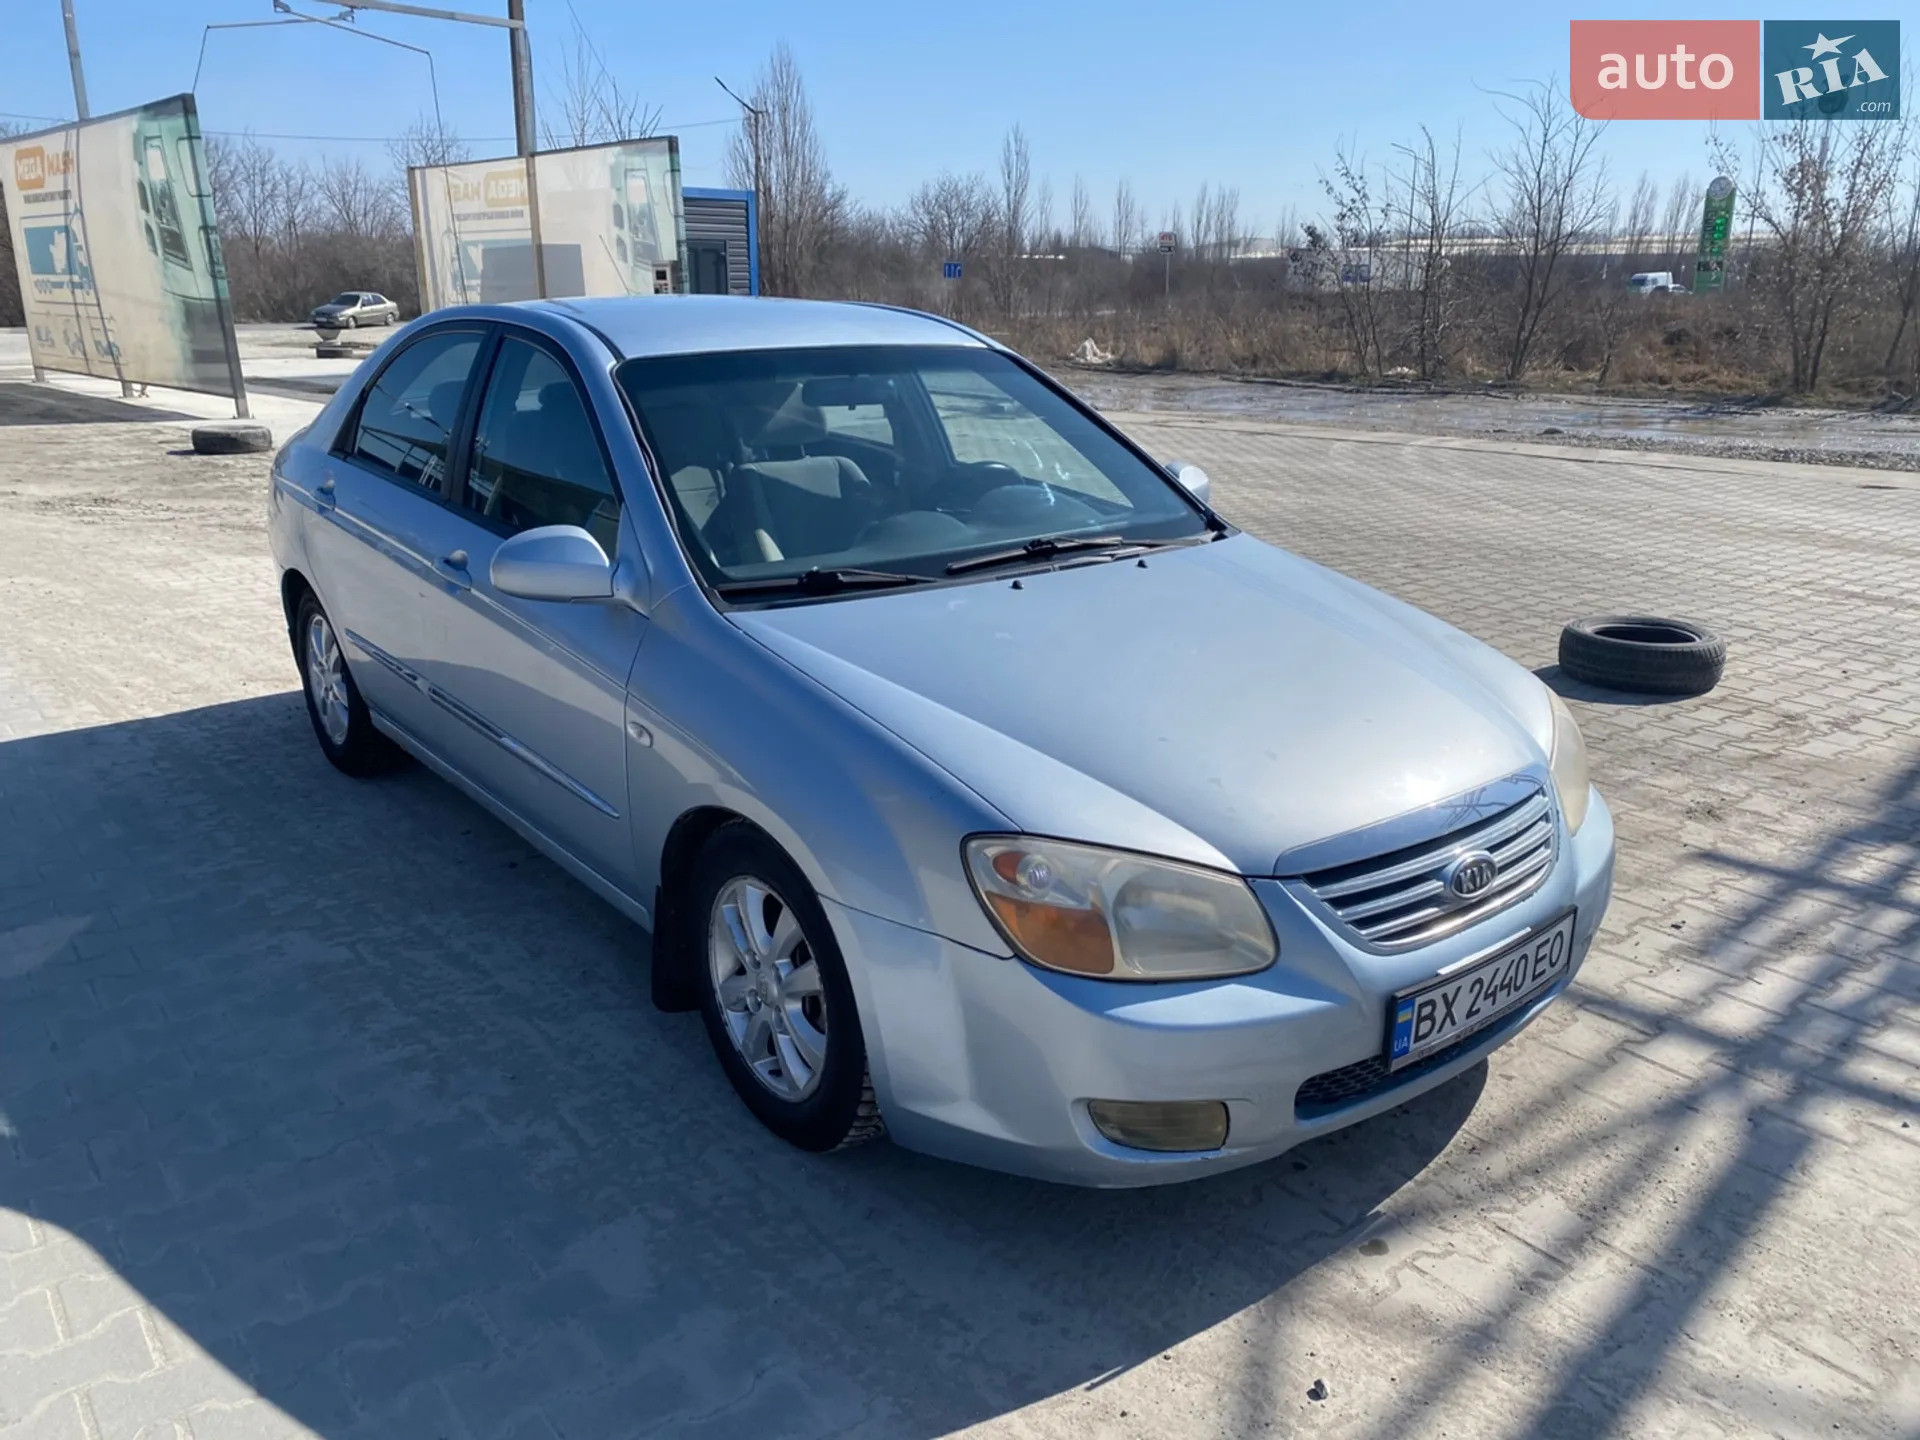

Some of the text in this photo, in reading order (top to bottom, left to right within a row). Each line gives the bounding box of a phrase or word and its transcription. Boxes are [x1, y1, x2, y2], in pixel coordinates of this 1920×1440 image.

[1413, 986, 1462, 1044] BX
[1465, 953, 1529, 1020] 2440
[1531, 930, 1564, 983] EO
[1394, 1036, 1408, 1051] UA
